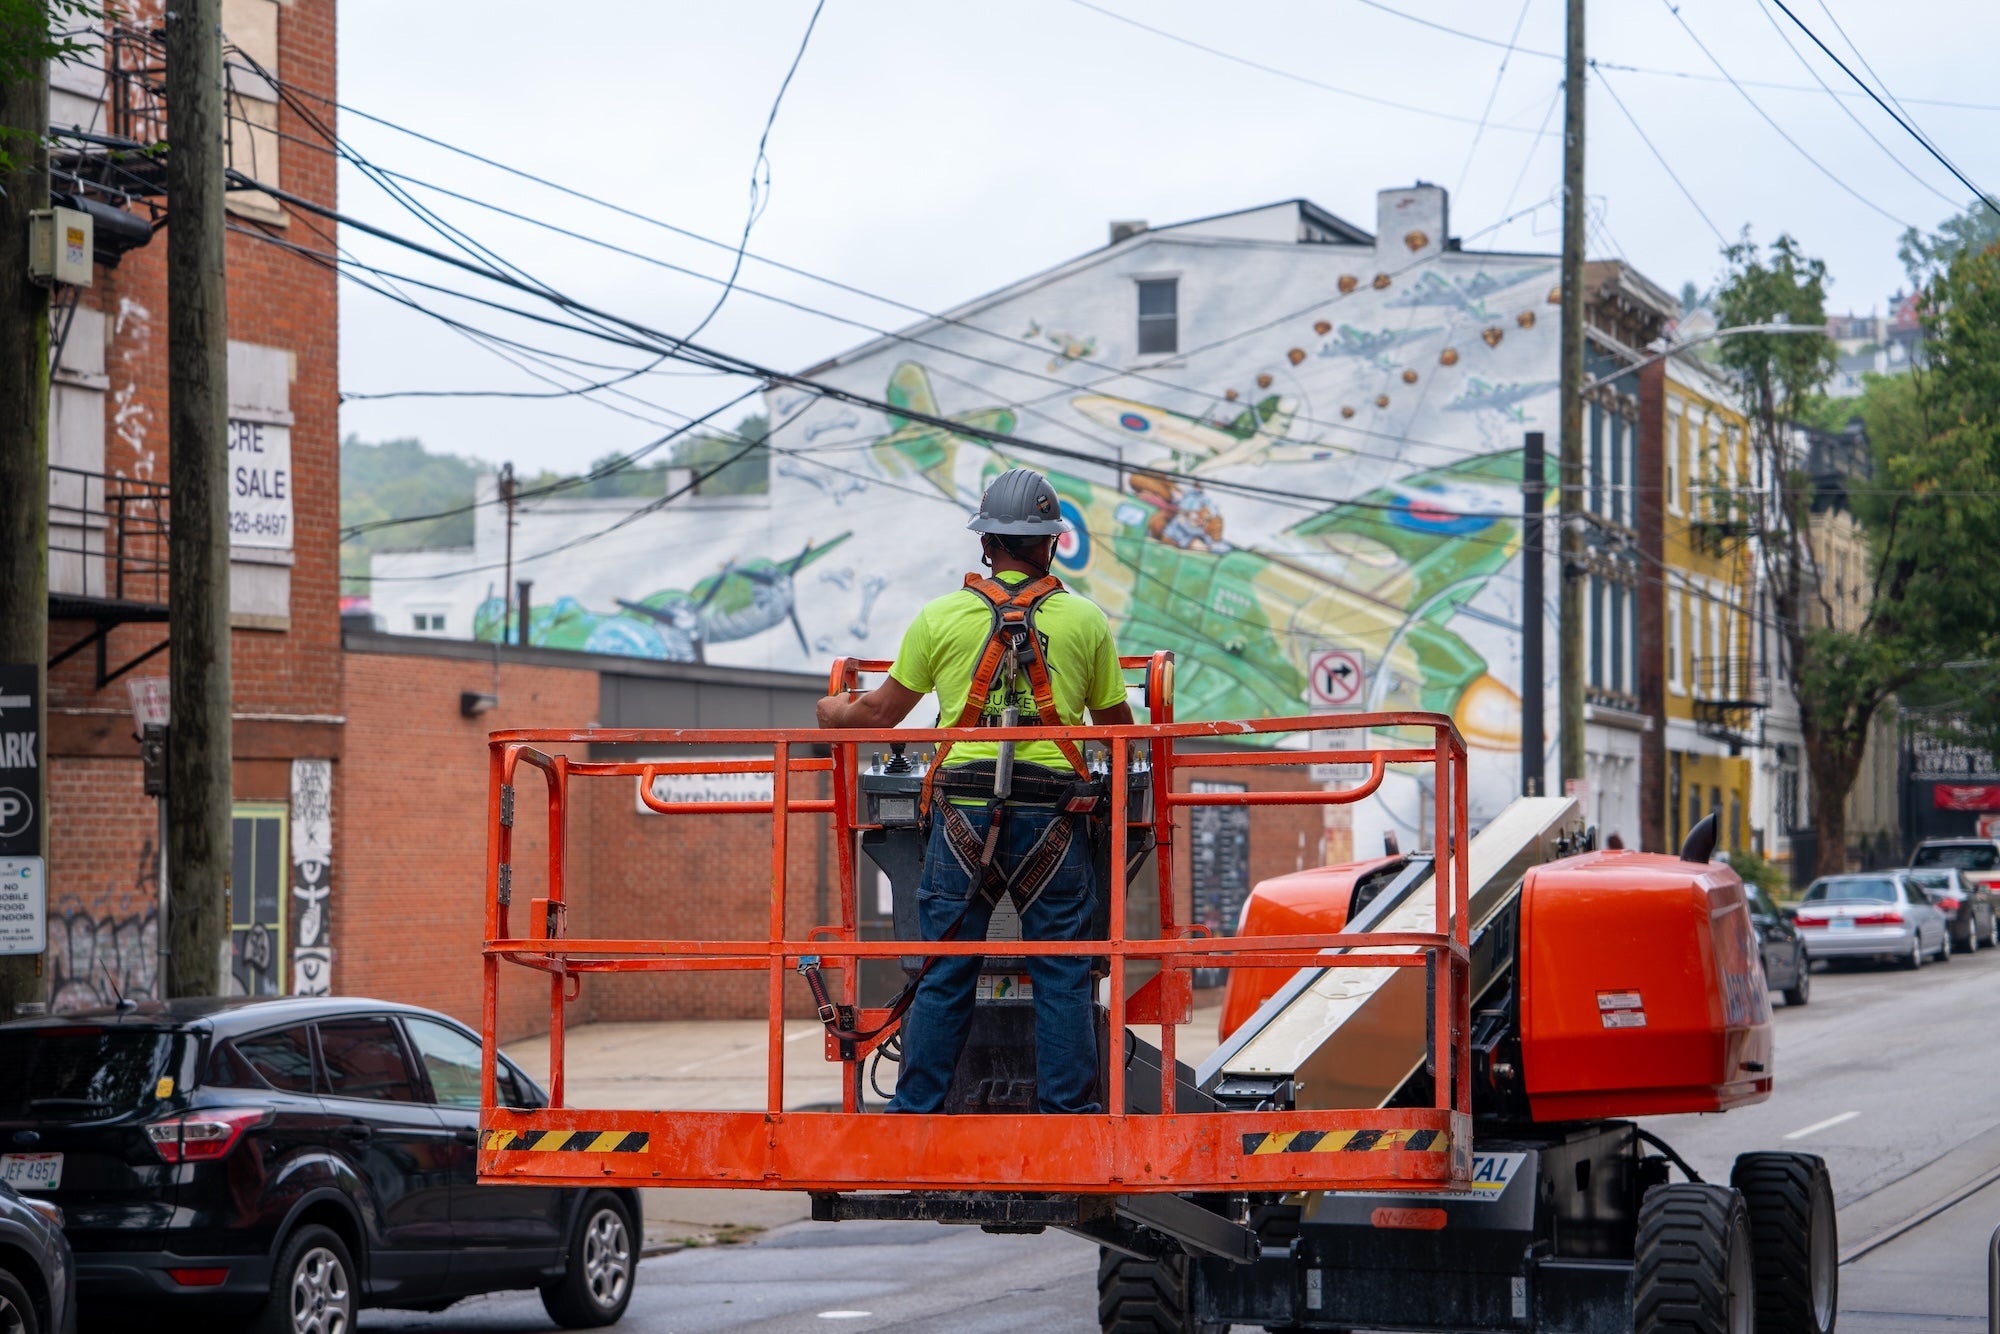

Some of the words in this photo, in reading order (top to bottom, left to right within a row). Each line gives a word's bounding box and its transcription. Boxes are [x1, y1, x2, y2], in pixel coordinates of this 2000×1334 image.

[236, 466, 286, 499] SALE
[4, 882, 19, 891] NO
[0, 912, 35, 921] NDORS
[1, 1161, 26, 1180] JEF
[27, 1161, 58, 1180] 4957
